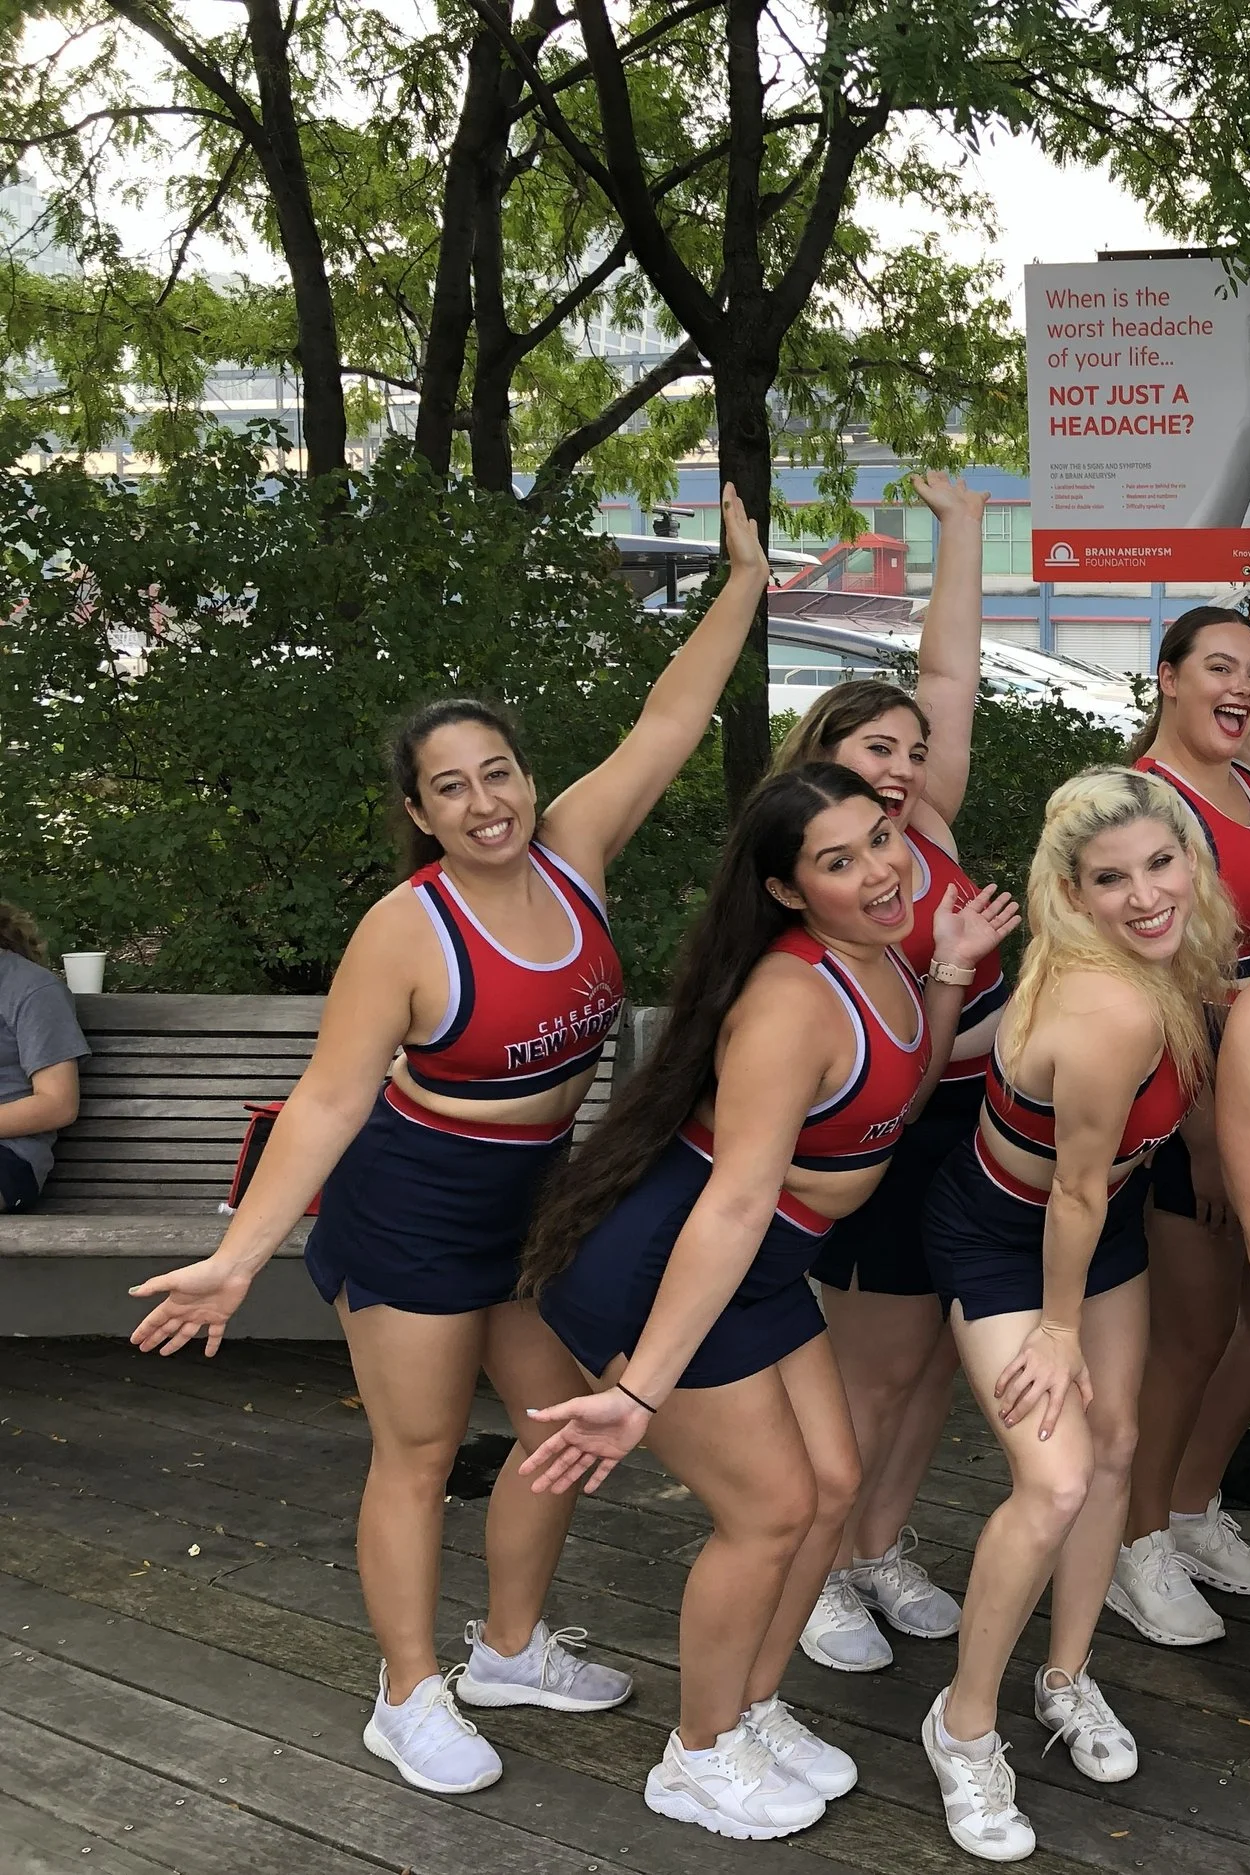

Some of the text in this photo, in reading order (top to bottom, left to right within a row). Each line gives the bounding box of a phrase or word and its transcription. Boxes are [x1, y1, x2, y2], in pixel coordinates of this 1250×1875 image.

[1045, 286, 1170, 309] When is the
[1047, 315, 1213, 339] worst headache
[1048, 345, 1174, 372] of your life...
[1049, 383, 1190, 406] NOT JUST A
[1050, 414, 1194, 436] HEADACHE?
[1050, 463, 1068, 471] KNOW
[1087, 462, 1105, 470] SIGNS
[1105, 462, 1119, 470] AND
[1119, 462, 1152, 470] SYMPTOMS
[1050, 472, 1058, 480] OF
[1065, 472, 1083, 480] BRAIN
[1084, 472, 1116, 480] ANEURYSM
[1085, 547, 1172, 557] BRAIN ANEURYSM
[1085, 558, 1146, 567] FOUNDATION
[538, 998, 606, 1034] CHEER
[504, 998, 622, 1070] NEW YORK
[859, 1115, 902, 1144] NE
